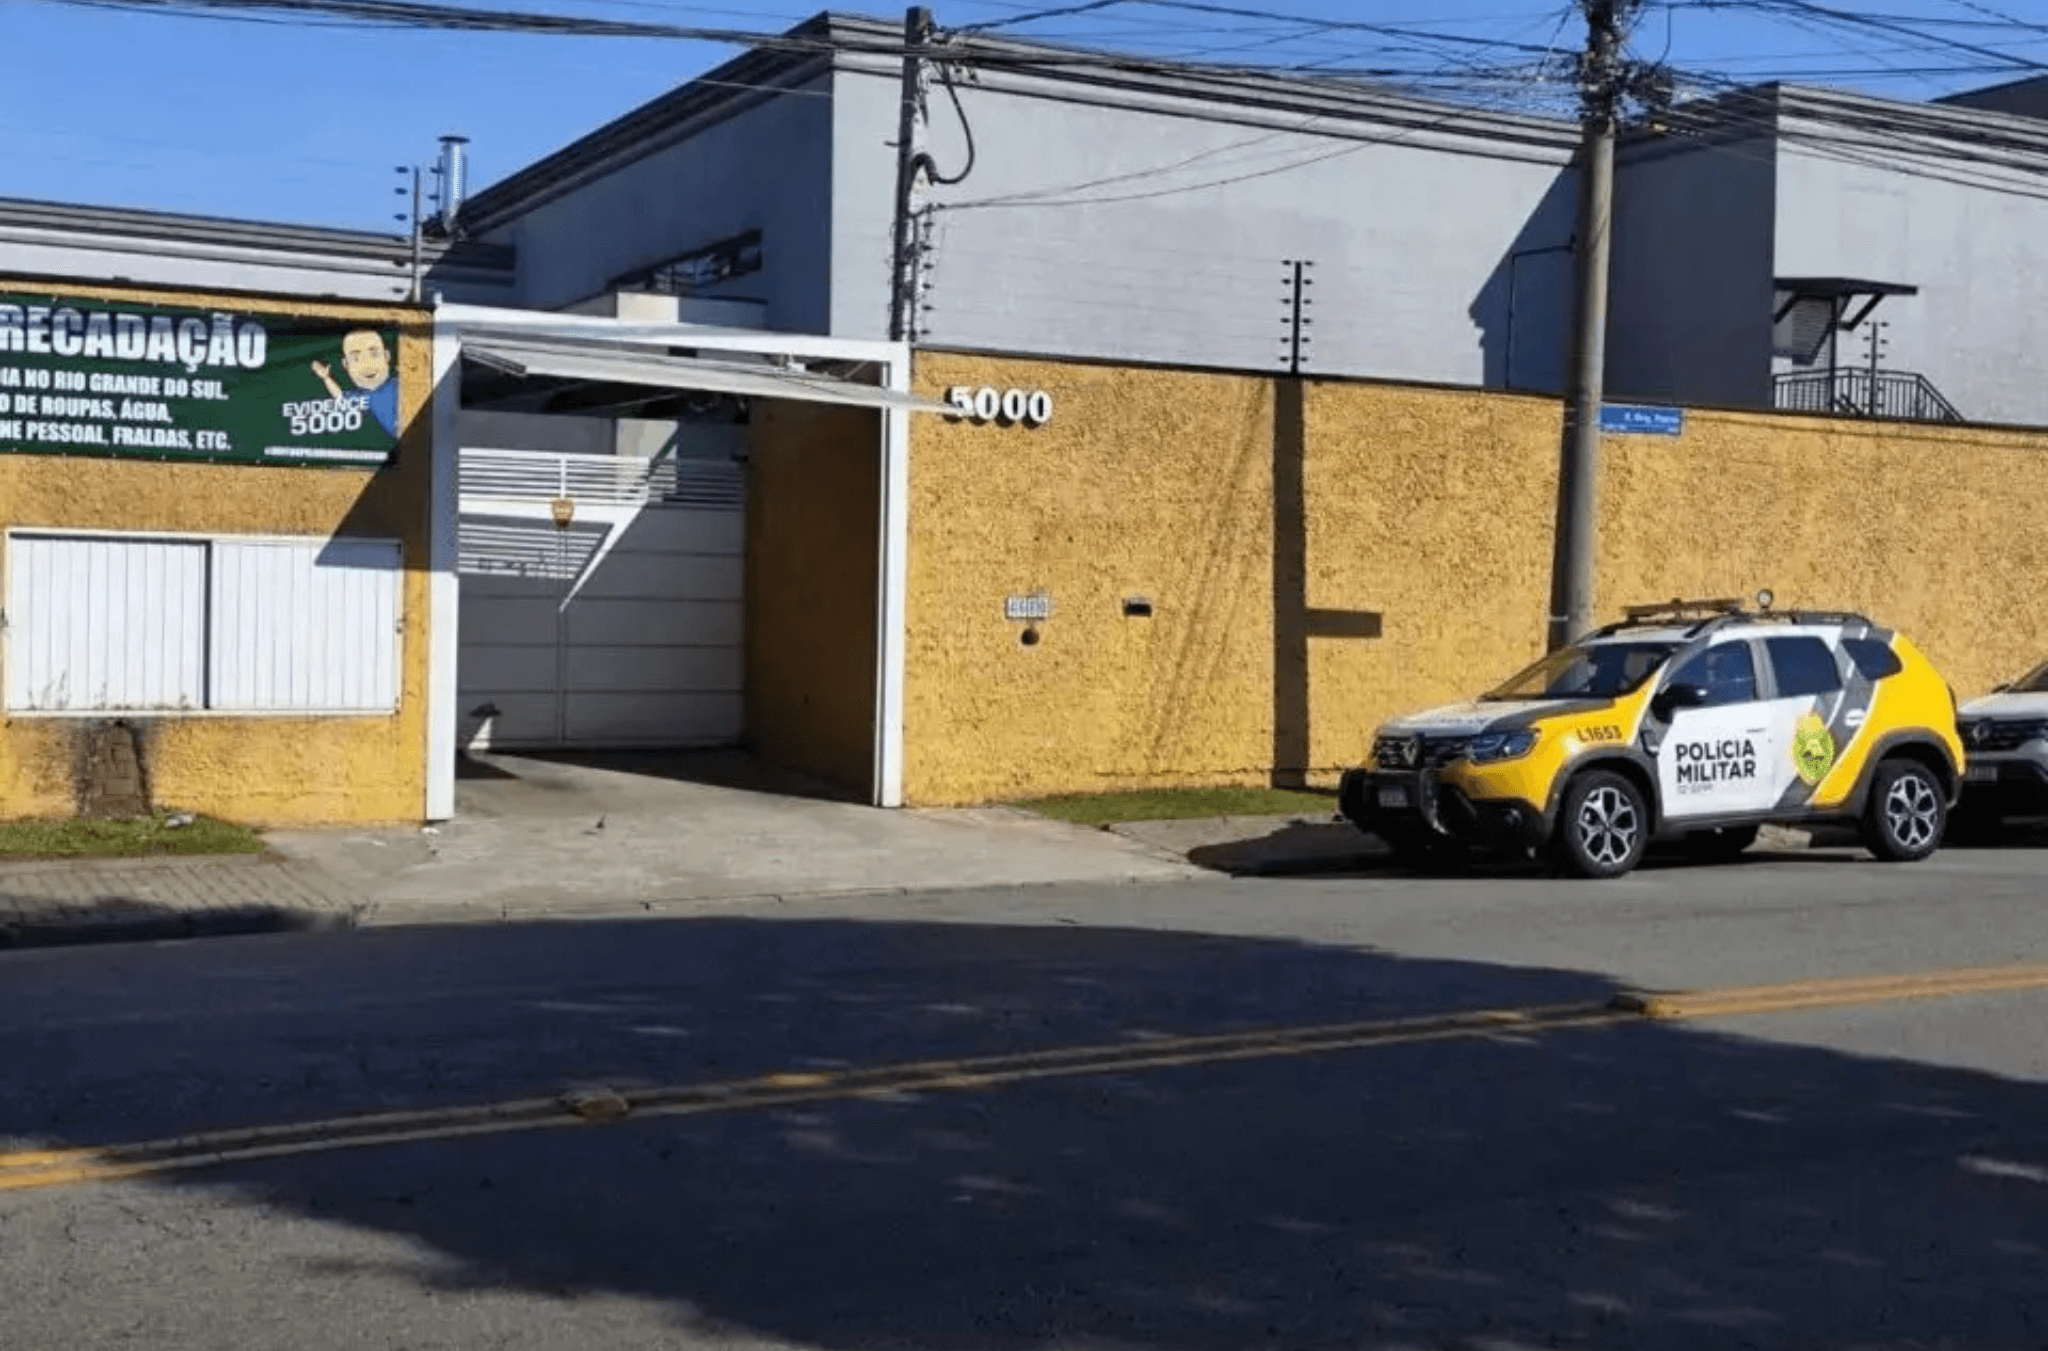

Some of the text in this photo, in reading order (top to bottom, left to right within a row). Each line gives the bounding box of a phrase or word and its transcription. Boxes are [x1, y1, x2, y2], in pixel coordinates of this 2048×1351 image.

[24, 368, 51, 389] NO
[54, 370, 86, 391] RIO
[89, 372, 160, 396] GRANDE
[163, 378, 188, 398] DO
[14, 394, 38, 415] DE
[41, 395, 118, 420] ROUPAS,
[119, 396, 173, 423] ÁGUA,
[282, 396, 370, 417] EVIDENCE
[951, 386, 1053, 423] 5000
[25, 421, 110, 446] PESSOAL,
[112, 425, 194, 450] FRALDAS,
[195, 430, 232, 451] ETC.
[290, 411, 362, 436] 5000
[1675, 739, 1755, 762] POLÍCIA
[1677, 760, 1756, 783] MILITAR
